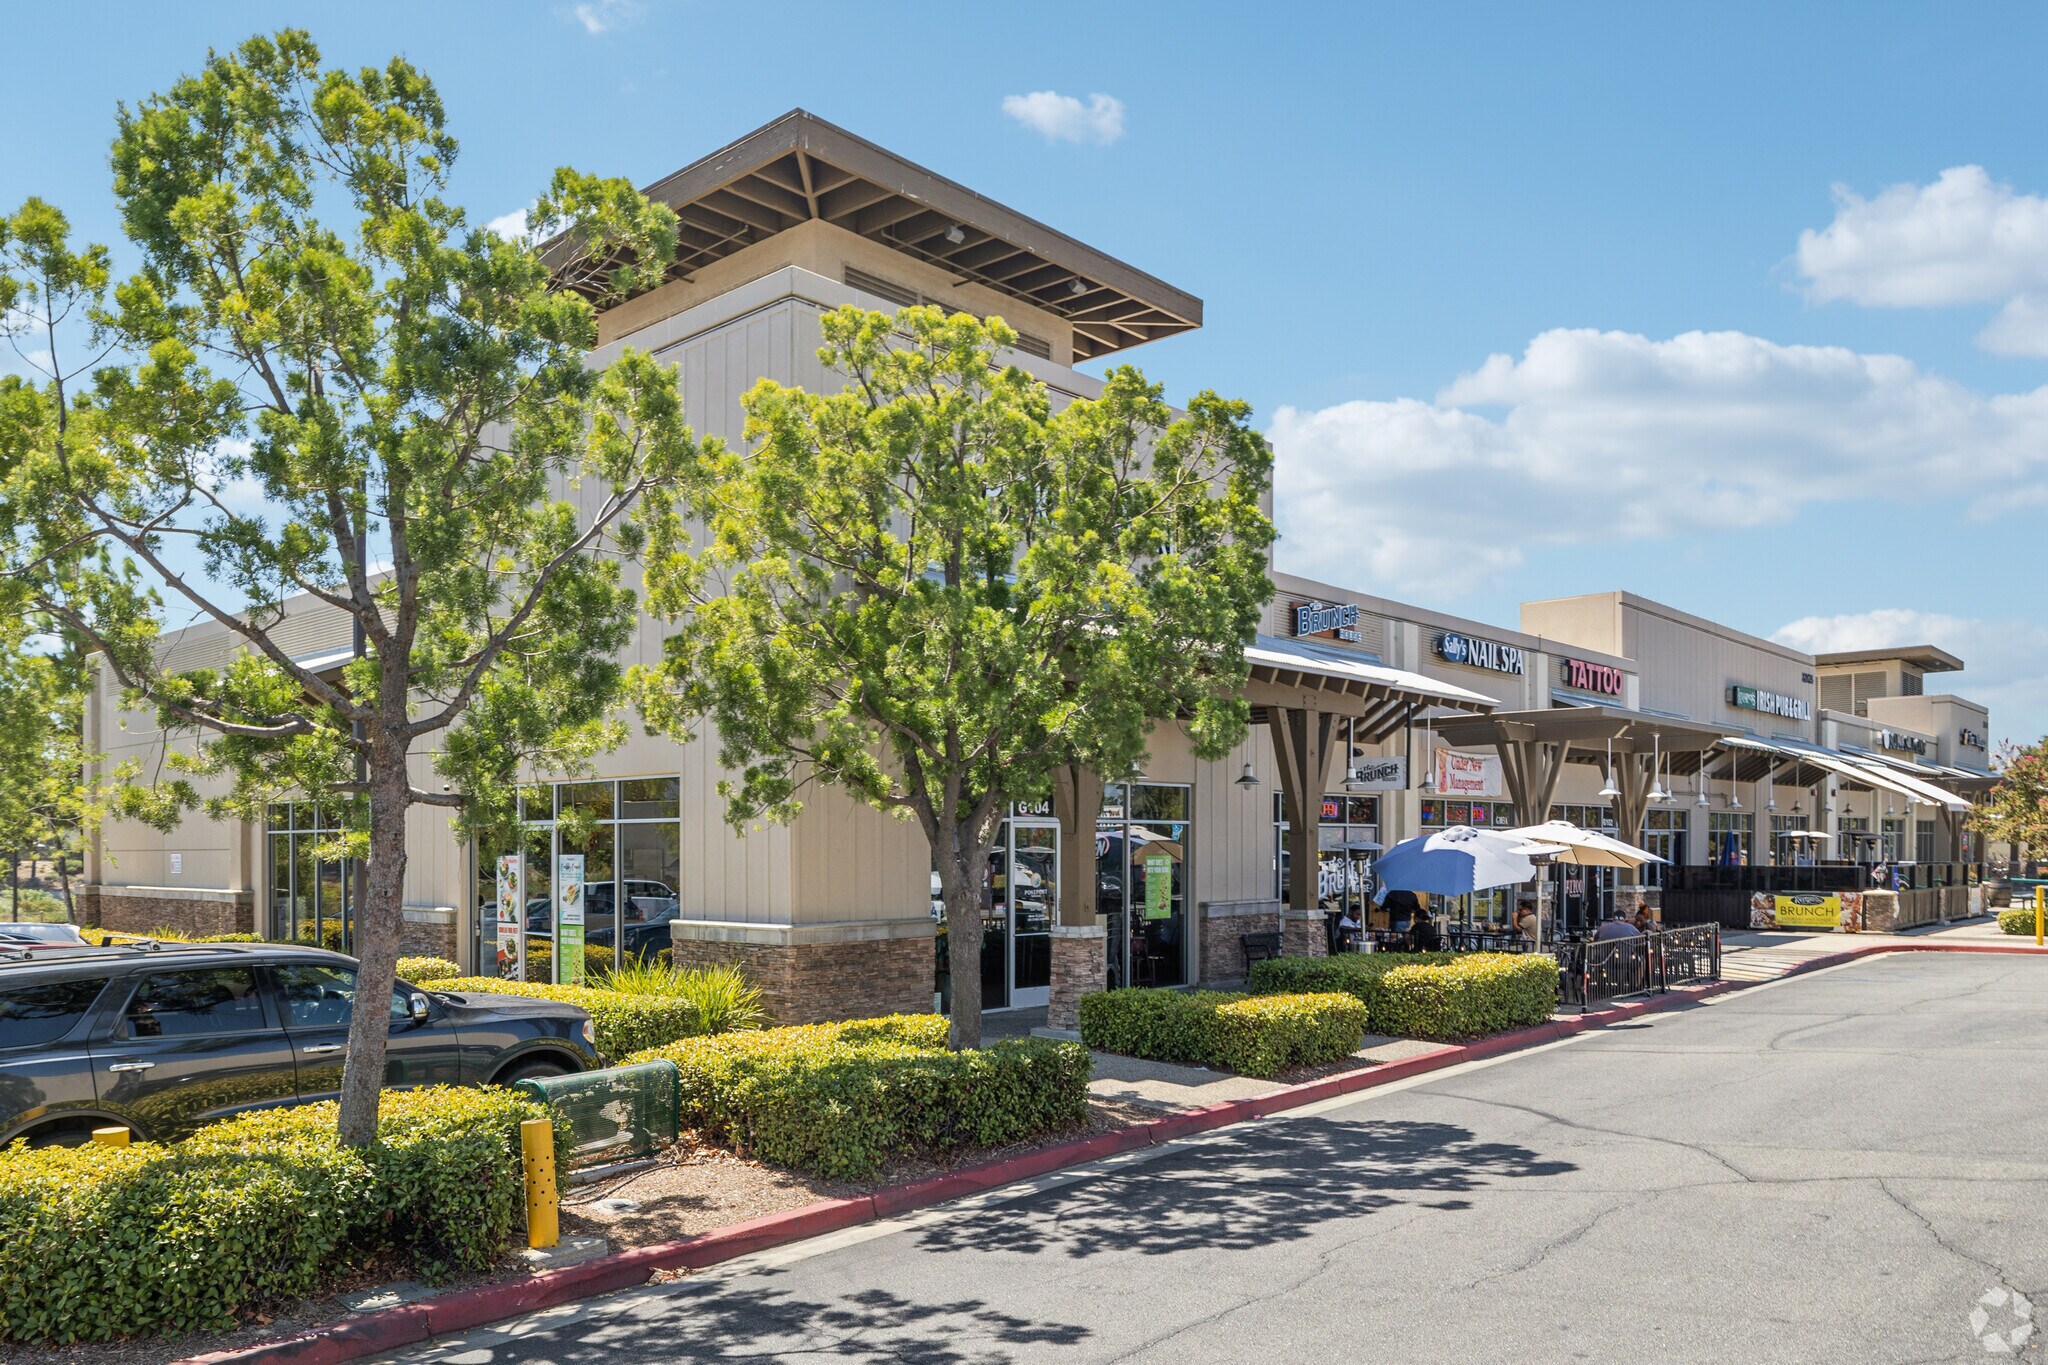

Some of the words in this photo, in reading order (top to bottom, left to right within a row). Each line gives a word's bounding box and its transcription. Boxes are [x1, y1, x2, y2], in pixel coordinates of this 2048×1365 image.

[1298, 604, 1360, 636] BRUNCH
[1444, 636, 1467, 660] Sally's
[1469, 638, 1499, 670] NAIL
[1501, 646, 1524, 675] SPA
[1569, 659, 1622, 695] TATTOO
[1757, 690, 1775, 714] IRISH
[1356, 764, 1399, 782] BRUNCH
[1451, 755, 1469, 771] Under
[1470, 757, 1482, 771] New
[1450, 773, 1484, 794] Management
[1780, 906, 1834, 916] BRUNCH
